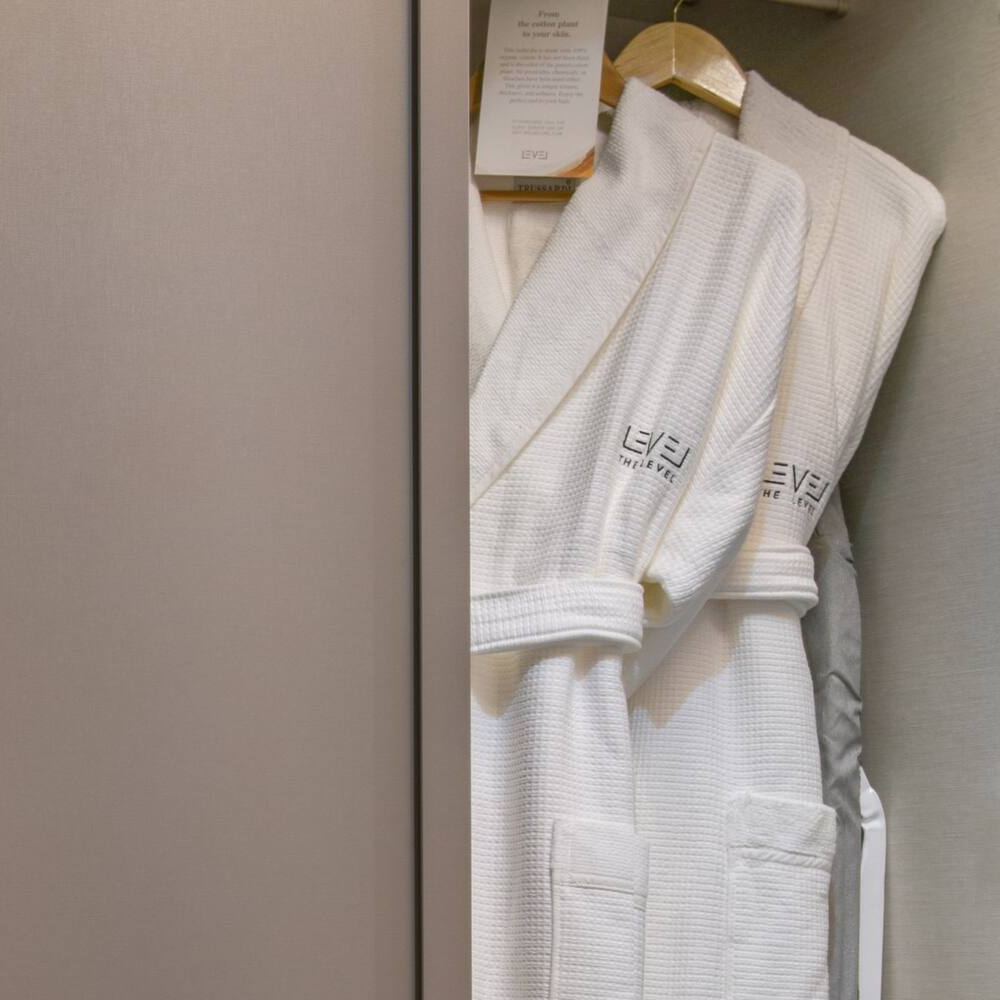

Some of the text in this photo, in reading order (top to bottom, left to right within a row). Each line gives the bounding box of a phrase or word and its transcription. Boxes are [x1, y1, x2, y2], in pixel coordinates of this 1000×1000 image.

[518, 20, 578, 29] the cotton plant
[532, 31, 551, 39] your
[762, 488, 781, 500] HE
